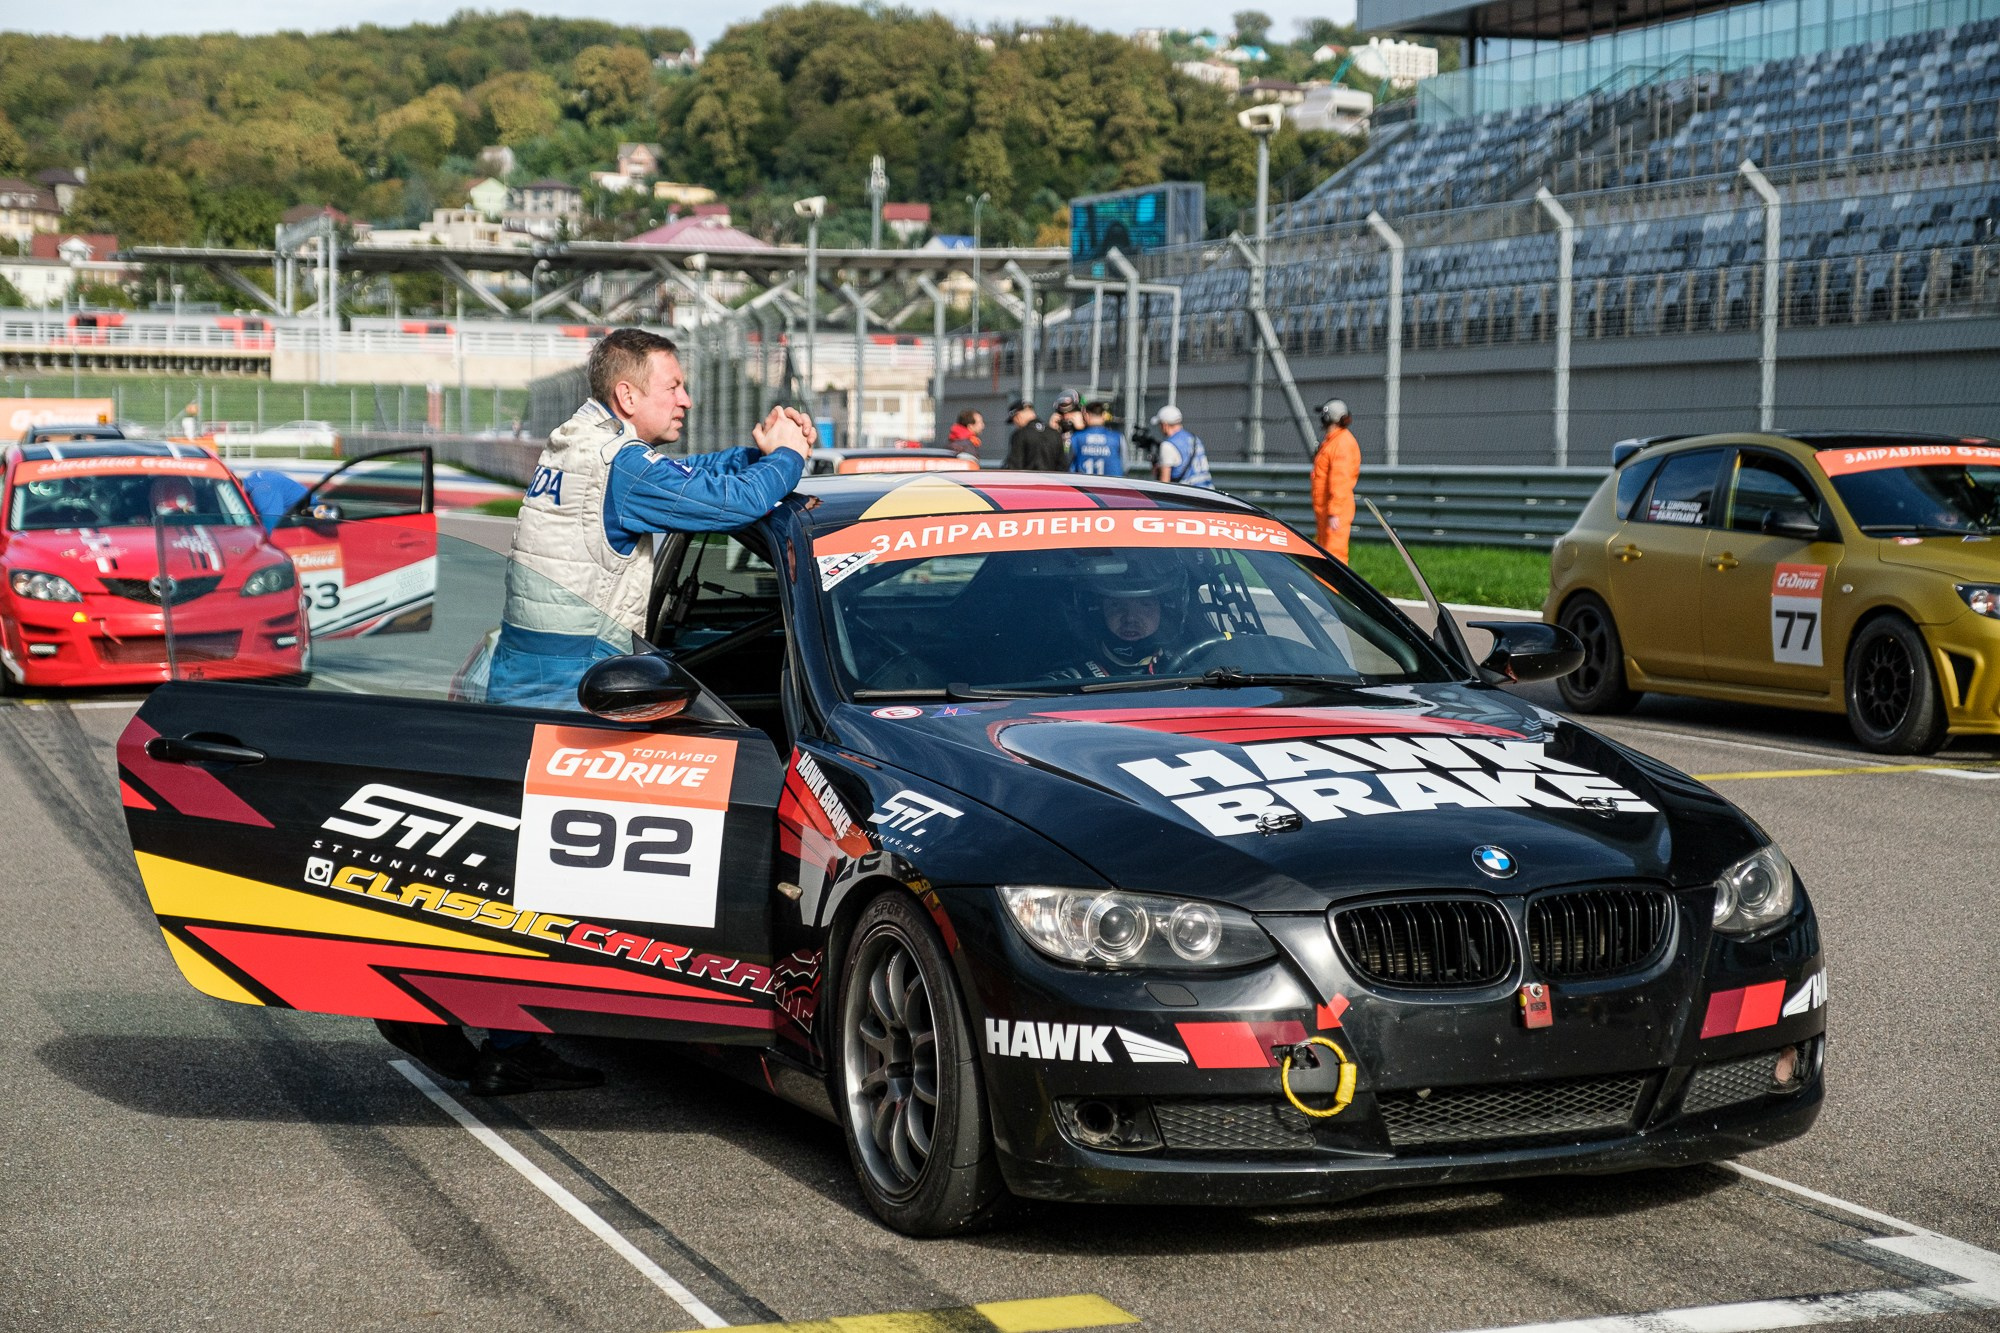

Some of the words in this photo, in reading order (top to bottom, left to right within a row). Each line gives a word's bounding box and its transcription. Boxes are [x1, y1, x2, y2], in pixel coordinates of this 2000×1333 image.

[1844, 446, 1952, 465] ЗАПРАВЛЕНО
[869, 516, 1116, 555] ЗАПРАВЛЕНО
[1206, 518, 1288, 536] ТОПЛИВО
[1775, 609, 1818, 651] 77
[632, 747, 719, 764] ТОПЛИВО
[1116, 737, 1601, 797] HAWK
[795, 750, 828, 800] HAWK
[818, 784, 853, 840] BRAKE
[1170, 770, 1661, 837] BRAKE
[549, 808, 694, 878] 92
[858, 829, 923, 854] STTUNING.RU
[311, 840, 510, 897] STTUNING.RU
[985, 1017, 1114, 1063] HAWK
